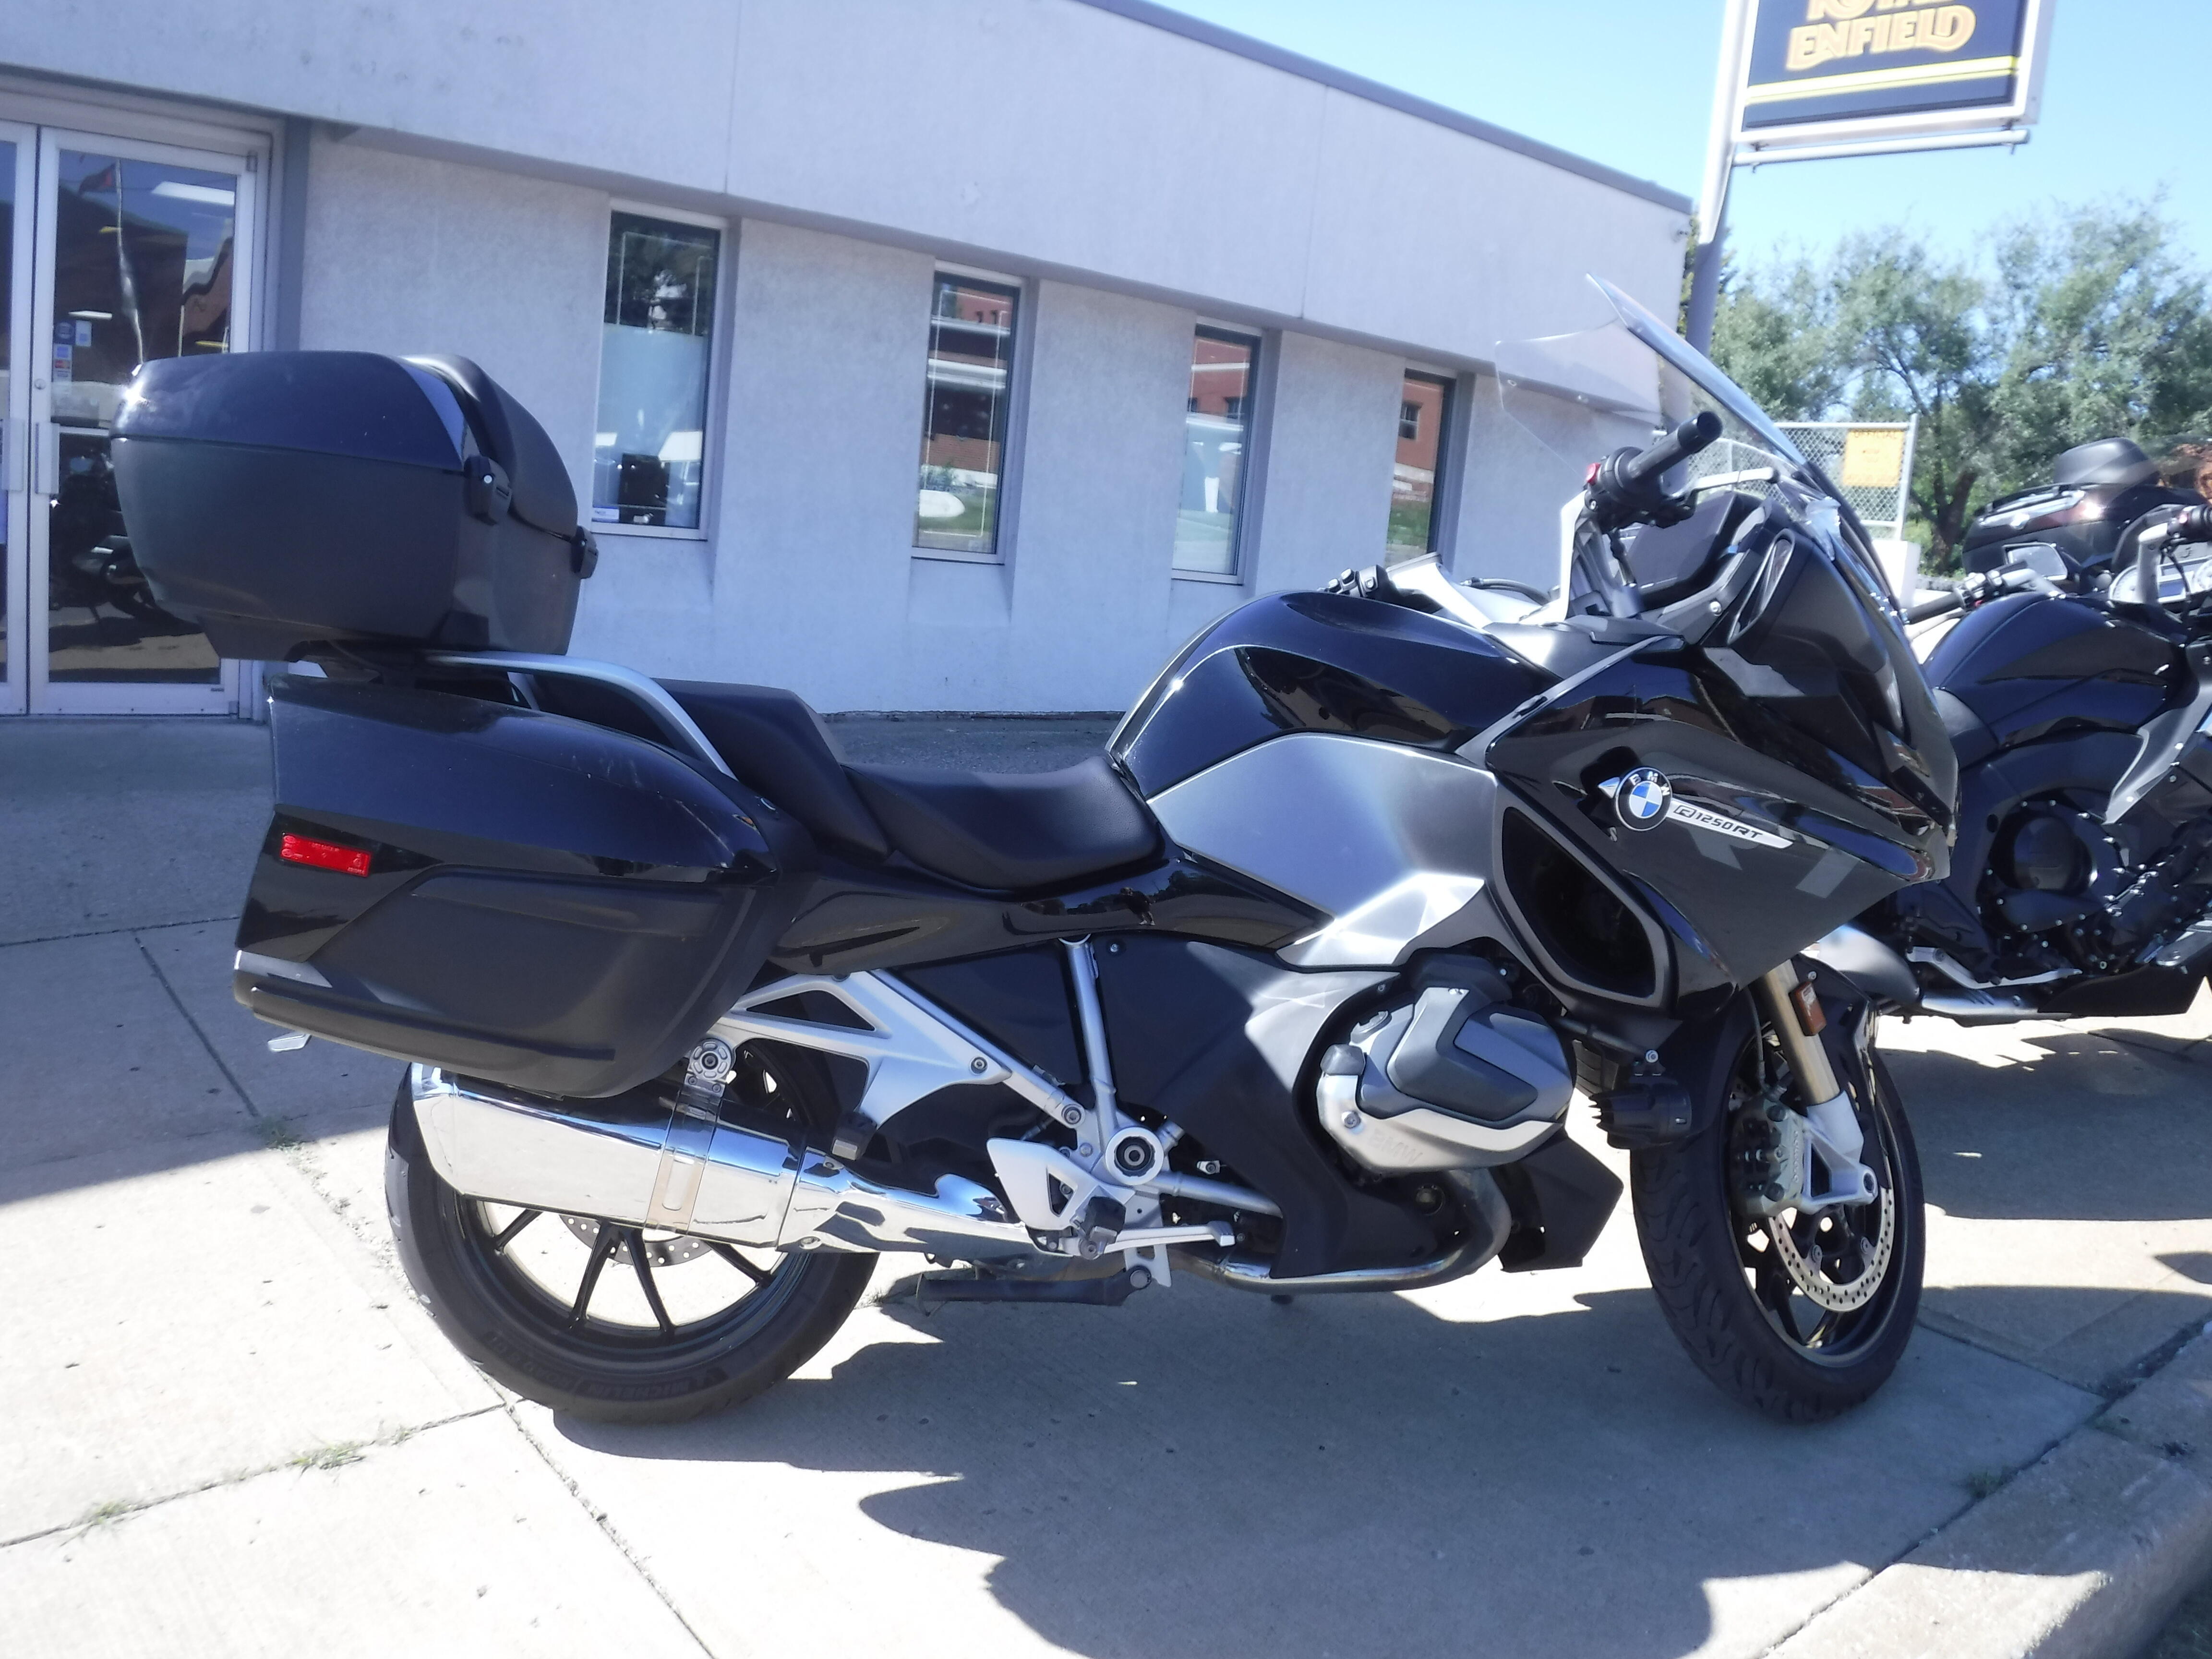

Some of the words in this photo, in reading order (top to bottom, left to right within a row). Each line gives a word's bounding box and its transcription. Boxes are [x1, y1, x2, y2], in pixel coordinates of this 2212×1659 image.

[1785, 4, 1977, 71] ENFIELD
[1629, 771, 1671, 796] BMW
[1368, 1129, 1423, 1164] BMW
[589, 1381, 690, 1398] MICHELIN
